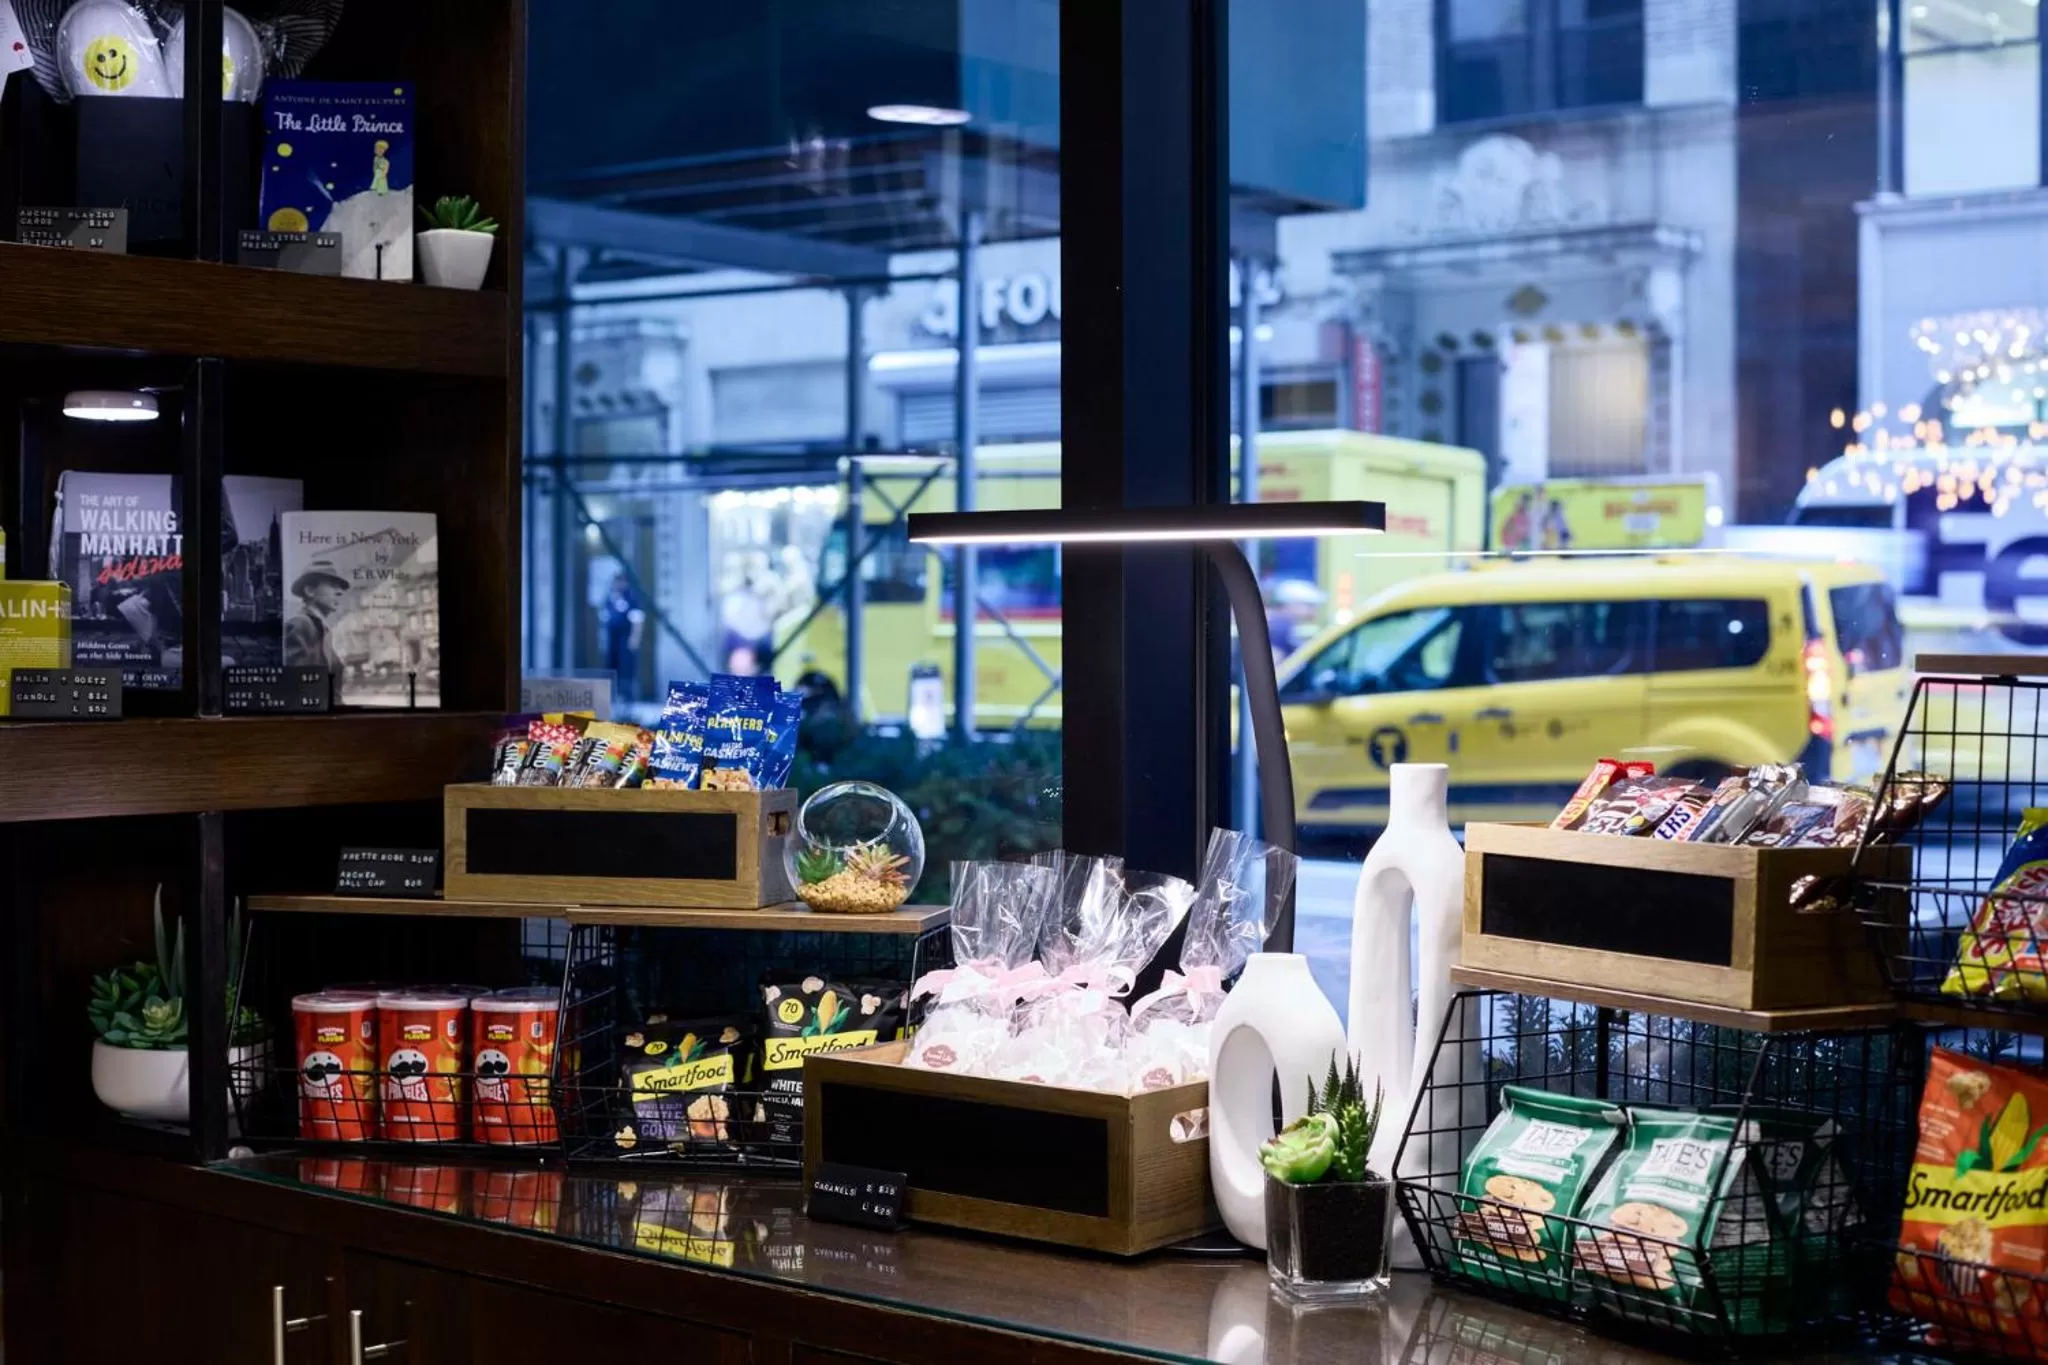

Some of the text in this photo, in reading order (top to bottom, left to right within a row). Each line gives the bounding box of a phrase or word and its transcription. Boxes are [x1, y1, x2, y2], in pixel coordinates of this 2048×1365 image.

[274, 111, 405, 133] The Little Prince
[68, 210, 116, 219] PLAYING
[20, 218, 111, 228] CARDS $10
[90, 237, 105, 247] $7
[243, 232, 307, 241] THE LITTLE
[241, 241, 280, 250] PRINCE
[80, 493, 138, 507] THE ART OF
[80, 509, 177, 532] WALKING
[299, 531, 421, 545] Here is New York
[81, 534, 183, 556] MANHATT
[375, 551, 389, 564] by
[77, 640, 131, 650] Hidden Gems
[90, 652, 103, 660] the
[105, 651, 122, 660] Side
[124, 651, 152, 661] Streets
[229, 666, 284, 675] MANHATTAN
[15, 674, 50, 684] MALIN
[74, 675, 107, 686] GOETZ
[15, 691, 57, 703] CANDLE
[708, 717, 764, 731] PLANTERS
[503, 742, 520, 769] KIND
[532, 742, 552, 769] KIND
[587, 739, 610, 766] KIND
[704, 748, 760, 759] CASHEWS
[340, 870, 377, 879] ARCHER
[339, 879, 361, 888] BALL
[367, 879, 386, 888] CAP
[784, 1002, 799, 1014] 70
[650, 1041, 670, 1052] 70
[770, 1078, 805, 1093] WHITE
[814, 1181, 857, 1197] CARAMELS
